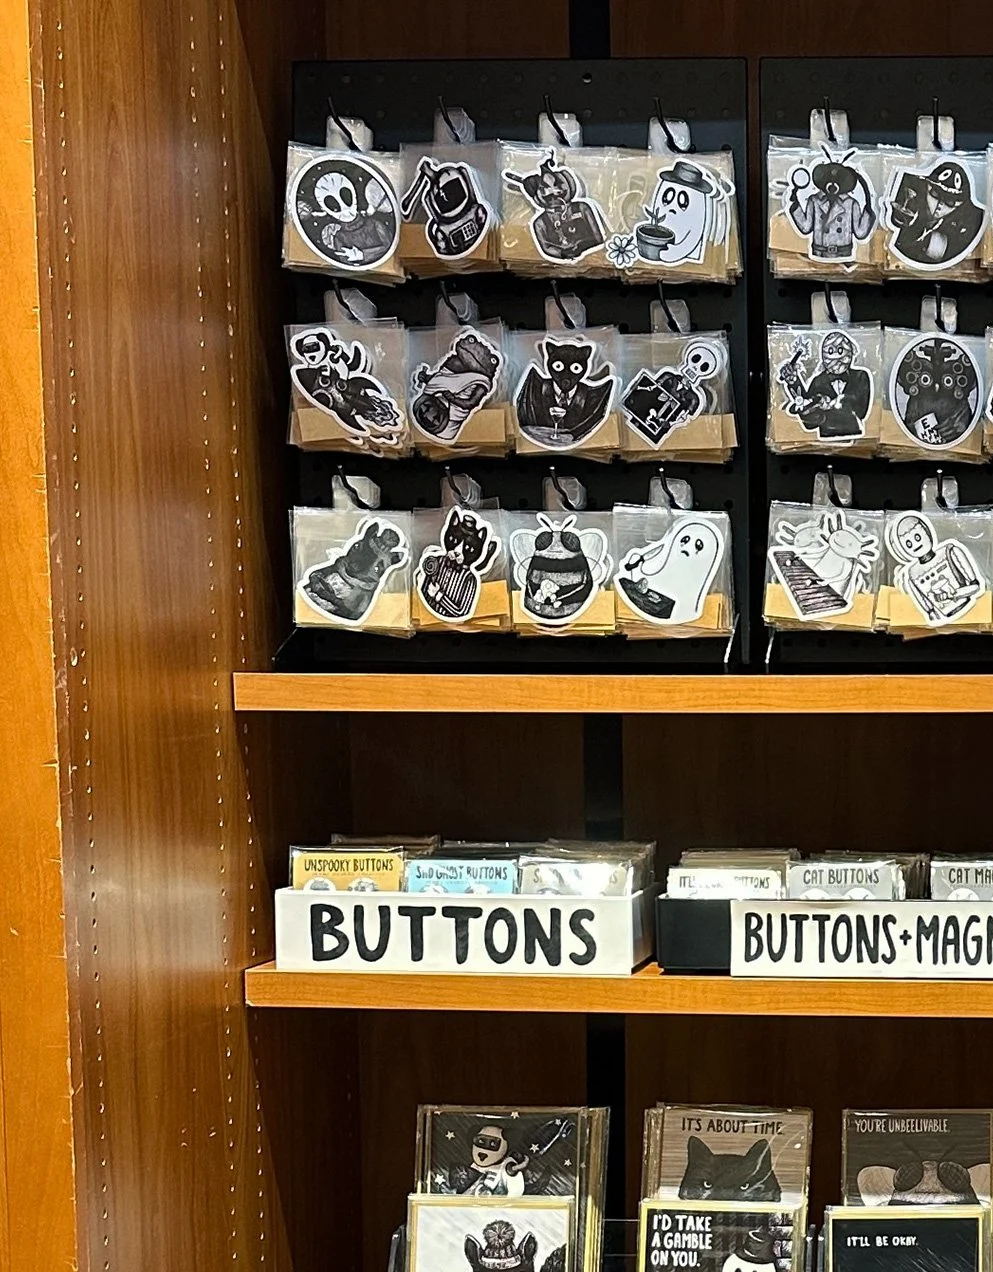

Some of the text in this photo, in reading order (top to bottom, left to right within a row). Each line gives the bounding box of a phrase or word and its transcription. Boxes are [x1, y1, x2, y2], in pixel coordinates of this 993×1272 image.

[304, 858, 394, 872] UNSPOOKY BUTTONS
[467, 866, 507, 880] BUTTONS
[803, 868, 879, 884] CAT BUTTONS
[949, 868, 969, 884] CAT
[309, 904, 597, 966] BUTTONS
[682, 1117, 784, 1135] IT'S ABOUT TIME
[854, 1118, 887, 1133] YOU'RE
[652, 1215, 712, 1232] I'D TAKE
[651, 1232, 712, 1250] A GAMBLE
[847, 1236, 918, 1246] IT'LL BE OKAY.
[651, 1250, 701, 1267] ON YOU.
